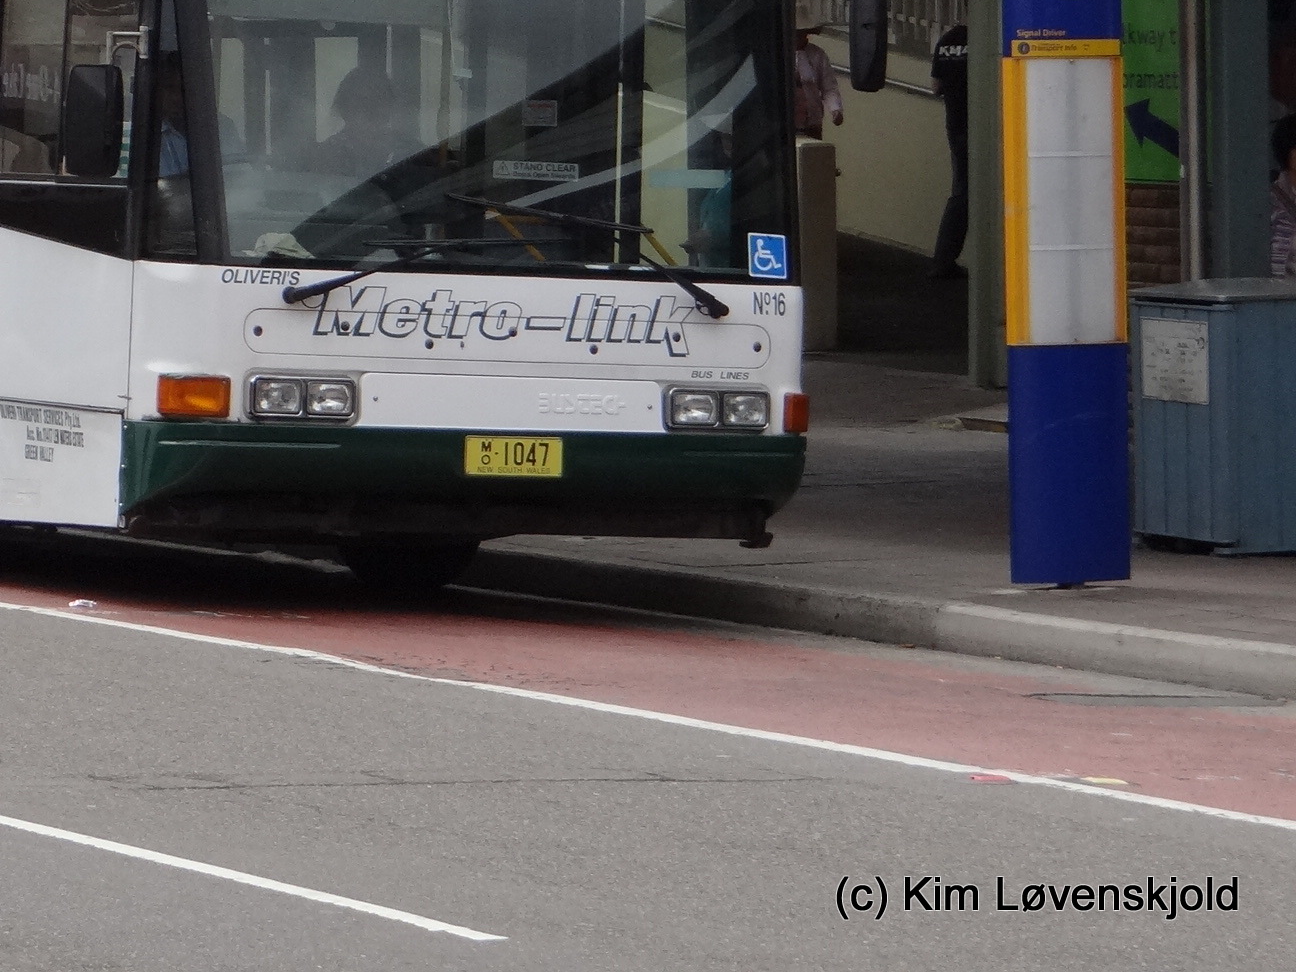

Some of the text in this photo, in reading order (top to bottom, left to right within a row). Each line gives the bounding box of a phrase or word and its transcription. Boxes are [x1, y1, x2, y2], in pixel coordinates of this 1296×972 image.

[1016, 29, 1066, 38] Signal Driver
[513, 162, 576, 173] STAND CLEAR
[221, 268, 301, 286] OLIVERI'S
[691, 370, 750, 380] BUS LINES
[477, 466, 551, 475] NEW SOUTH WALES
